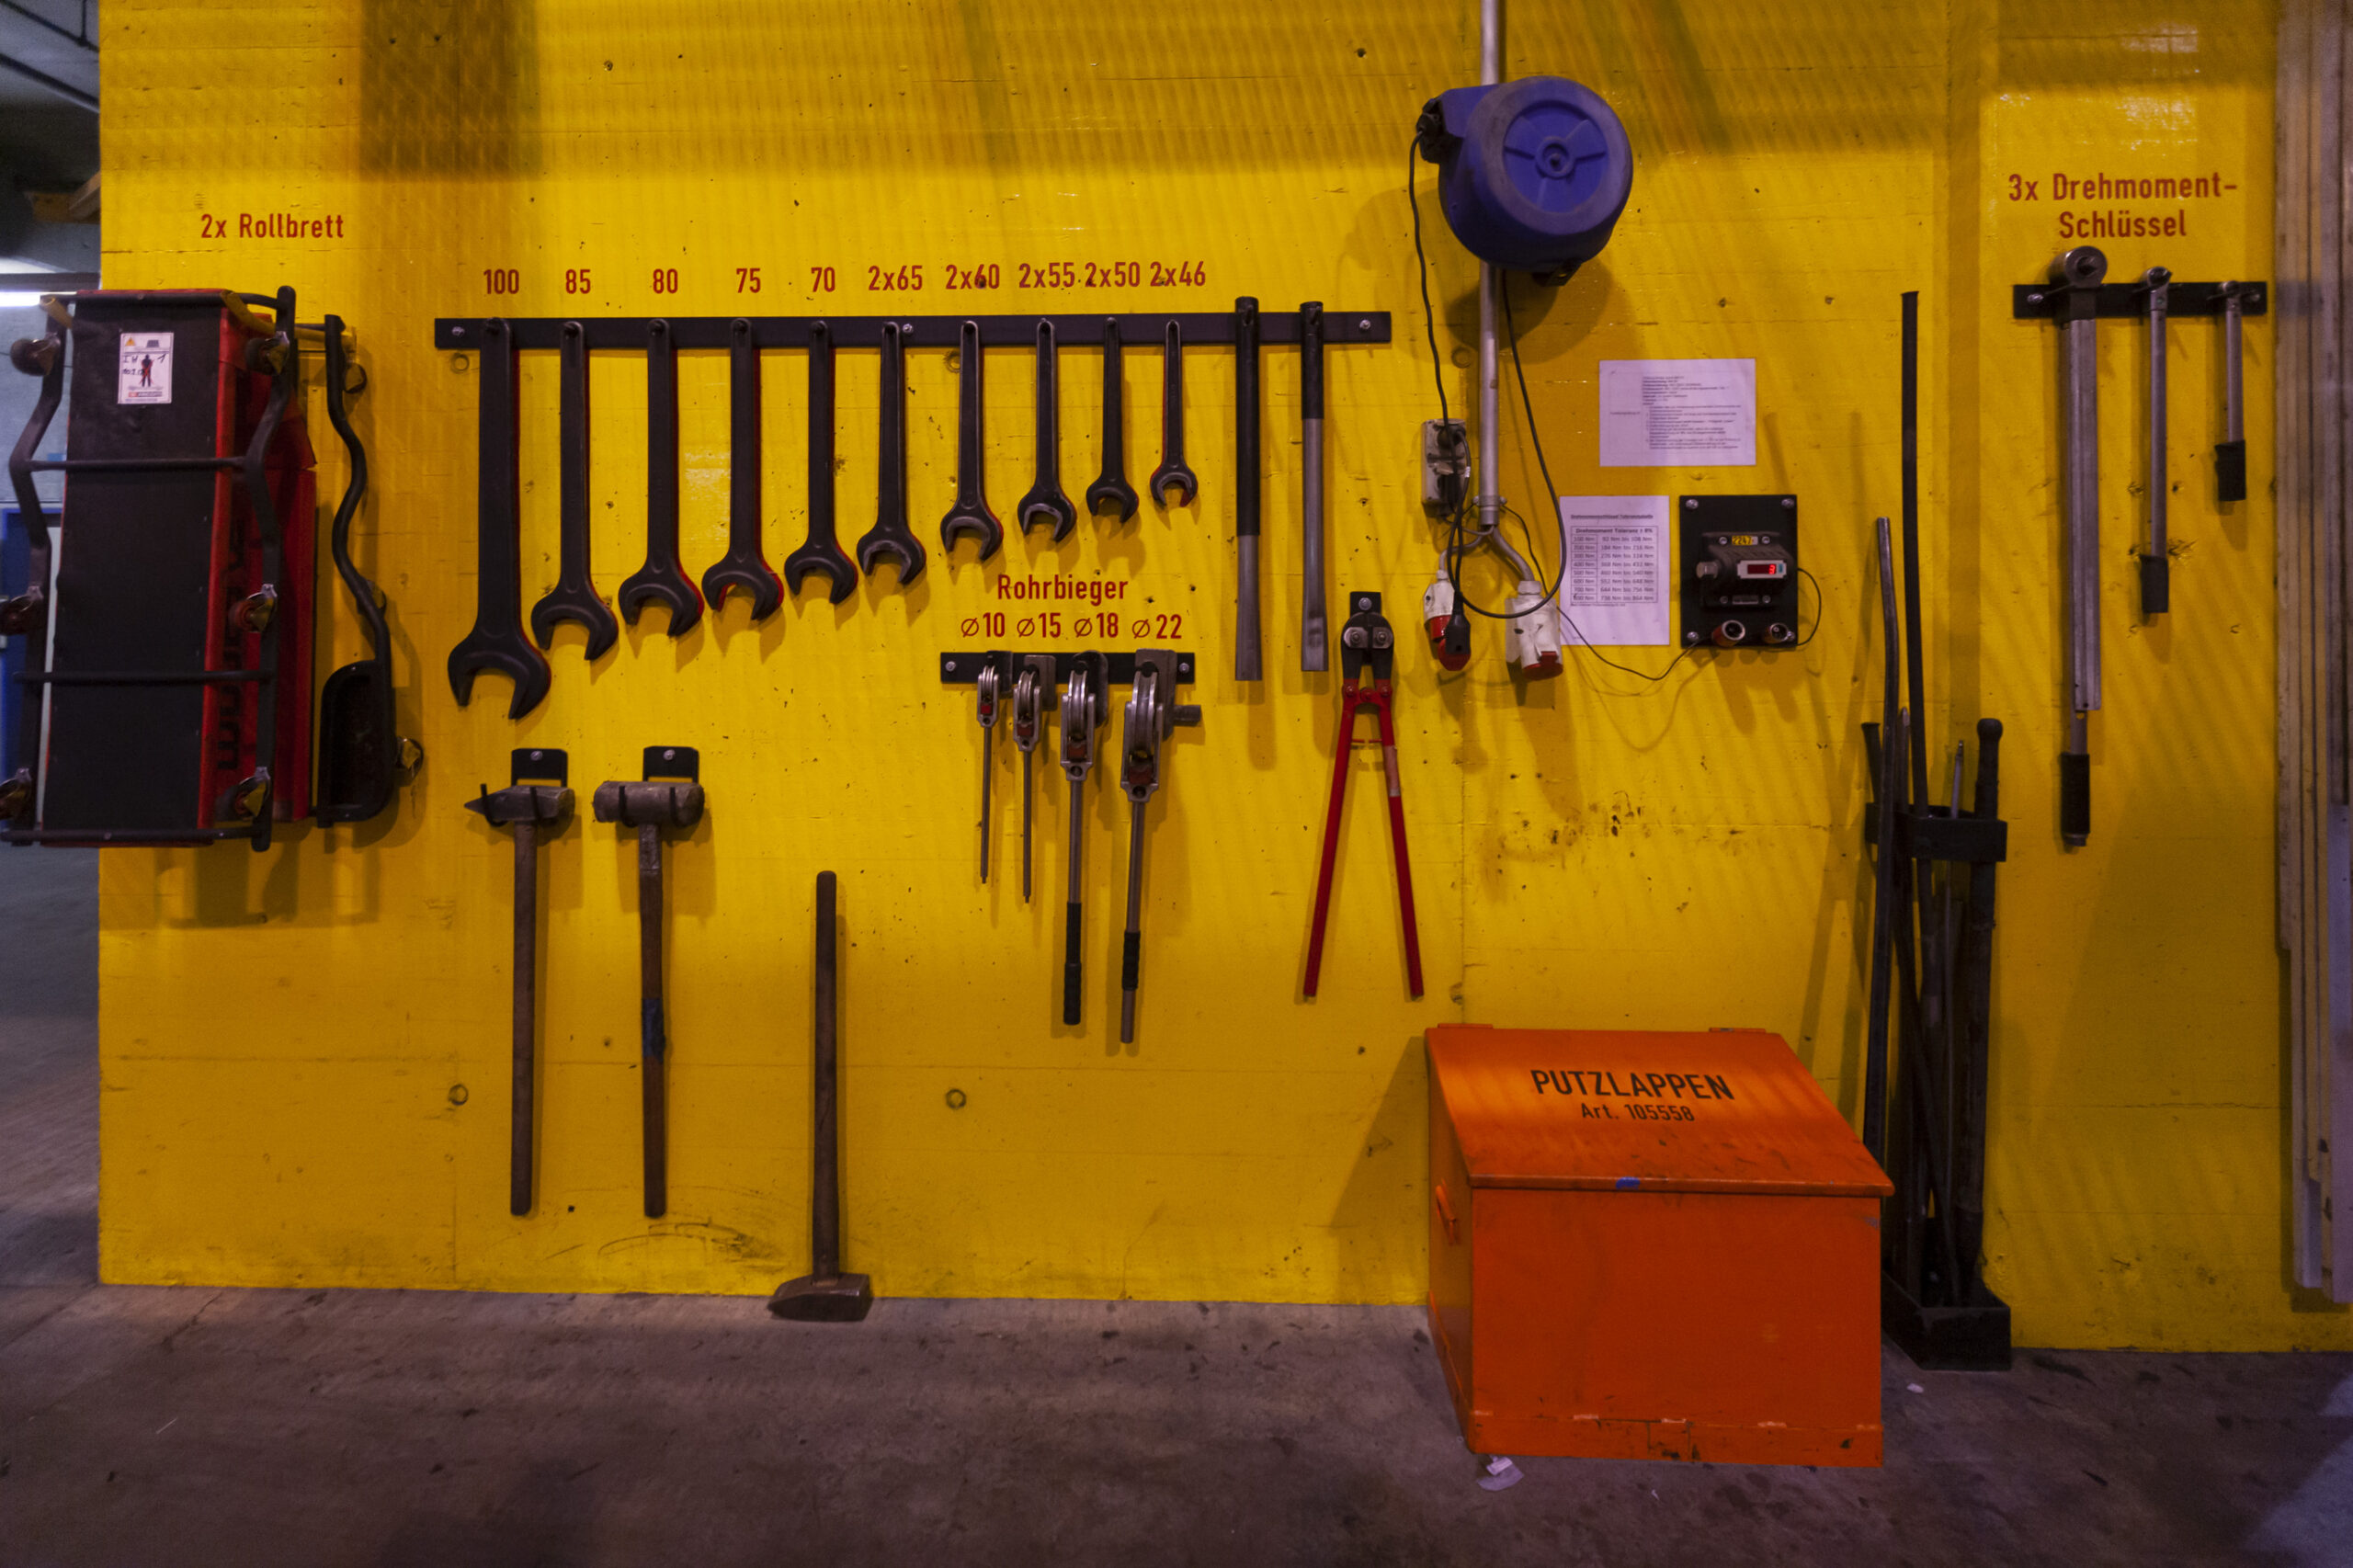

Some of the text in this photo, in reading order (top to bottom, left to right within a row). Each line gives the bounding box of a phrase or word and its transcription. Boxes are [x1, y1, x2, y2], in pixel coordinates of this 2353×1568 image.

[2009, 172, 2237, 201] 3x Drehmoment-
[201, 213, 344, 239] 2x Rollbrett
[2059, 210, 2187, 239] Schlüssel
[483, 268, 519, 295] 100
[565, 268, 591, 294] 85
[653, 268, 678, 294] 80
[736, 267, 761, 293] 75
[811, 267, 835, 292] 70
[869, 265, 923, 291] 2x65
[946, 264, 1000, 290] 2x60
[1018, 262, 1075, 289] 2x55
[1085, 261, 1141, 288] 2x50
[1150, 261, 1206, 287] 2x46
[997, 574, 1129, 607] Rohrbieger
[1530, 1070, 1734, 1100] PUTZLAPPEN
[1581, 1103, 1696, 1122] Art. 105558
